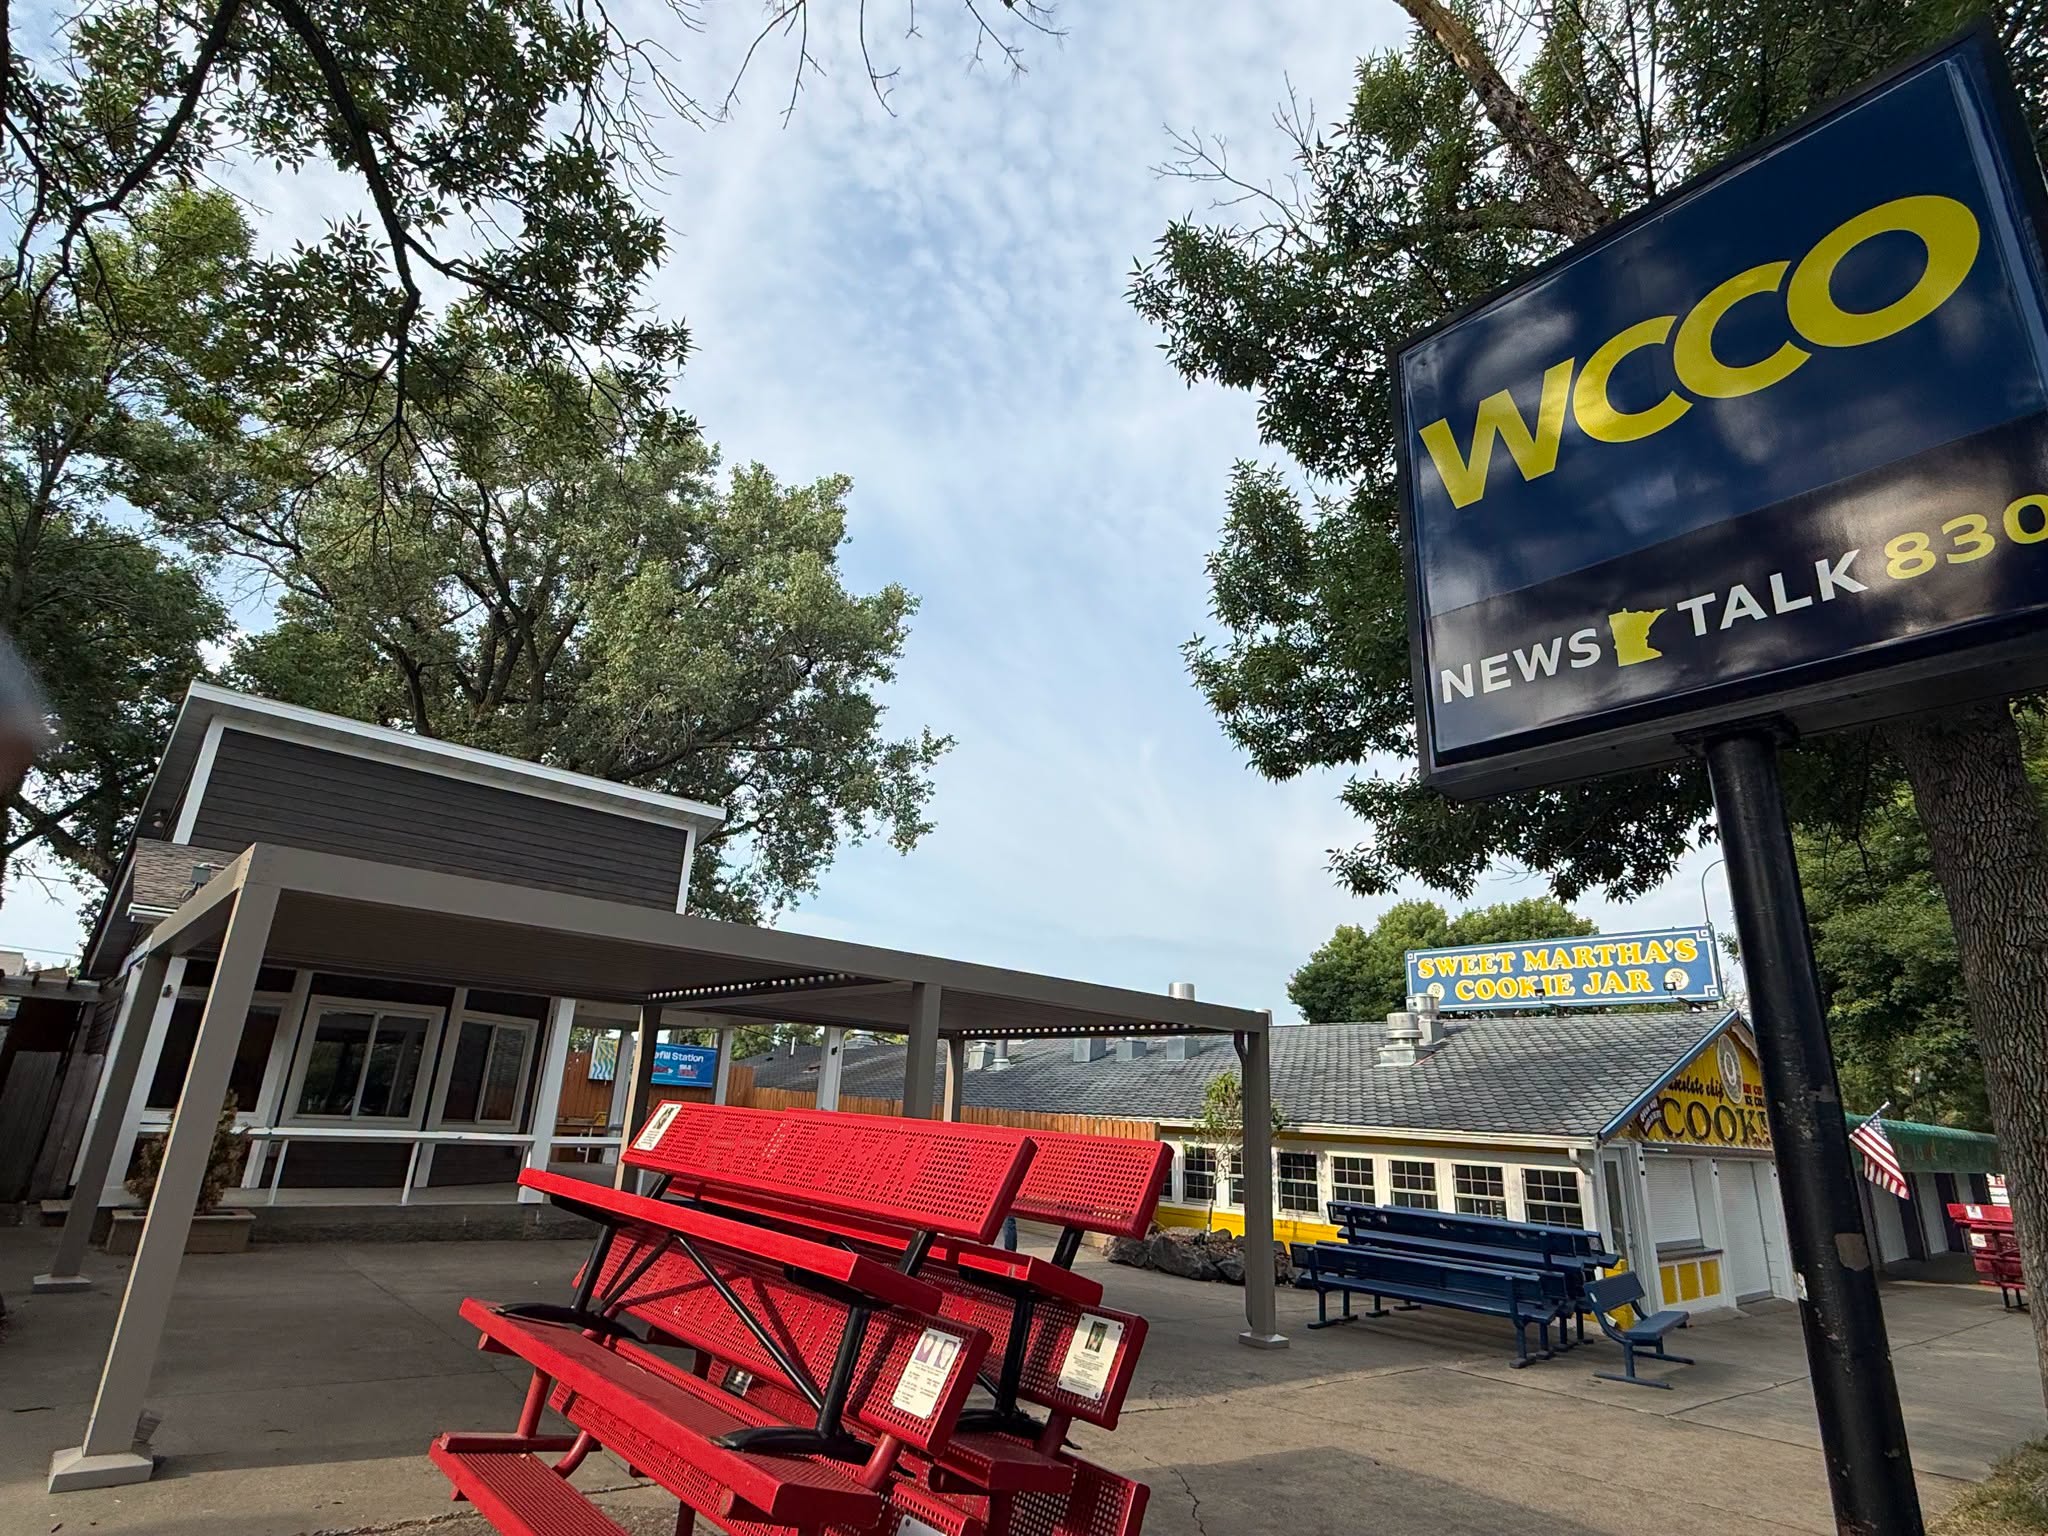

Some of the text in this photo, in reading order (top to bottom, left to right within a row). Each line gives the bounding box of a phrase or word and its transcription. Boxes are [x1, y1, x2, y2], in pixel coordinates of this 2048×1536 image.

[1419, 194, 1981, 510] WCCO
[1440, 493, 2048, 704] NEWS TALK 830
[1417, 938, 1699, 979] SWEET MARTHA'S
[1454, 969, 1655, 1002] COOKIE JAR
[672, 1051, 704, 1063] Station
